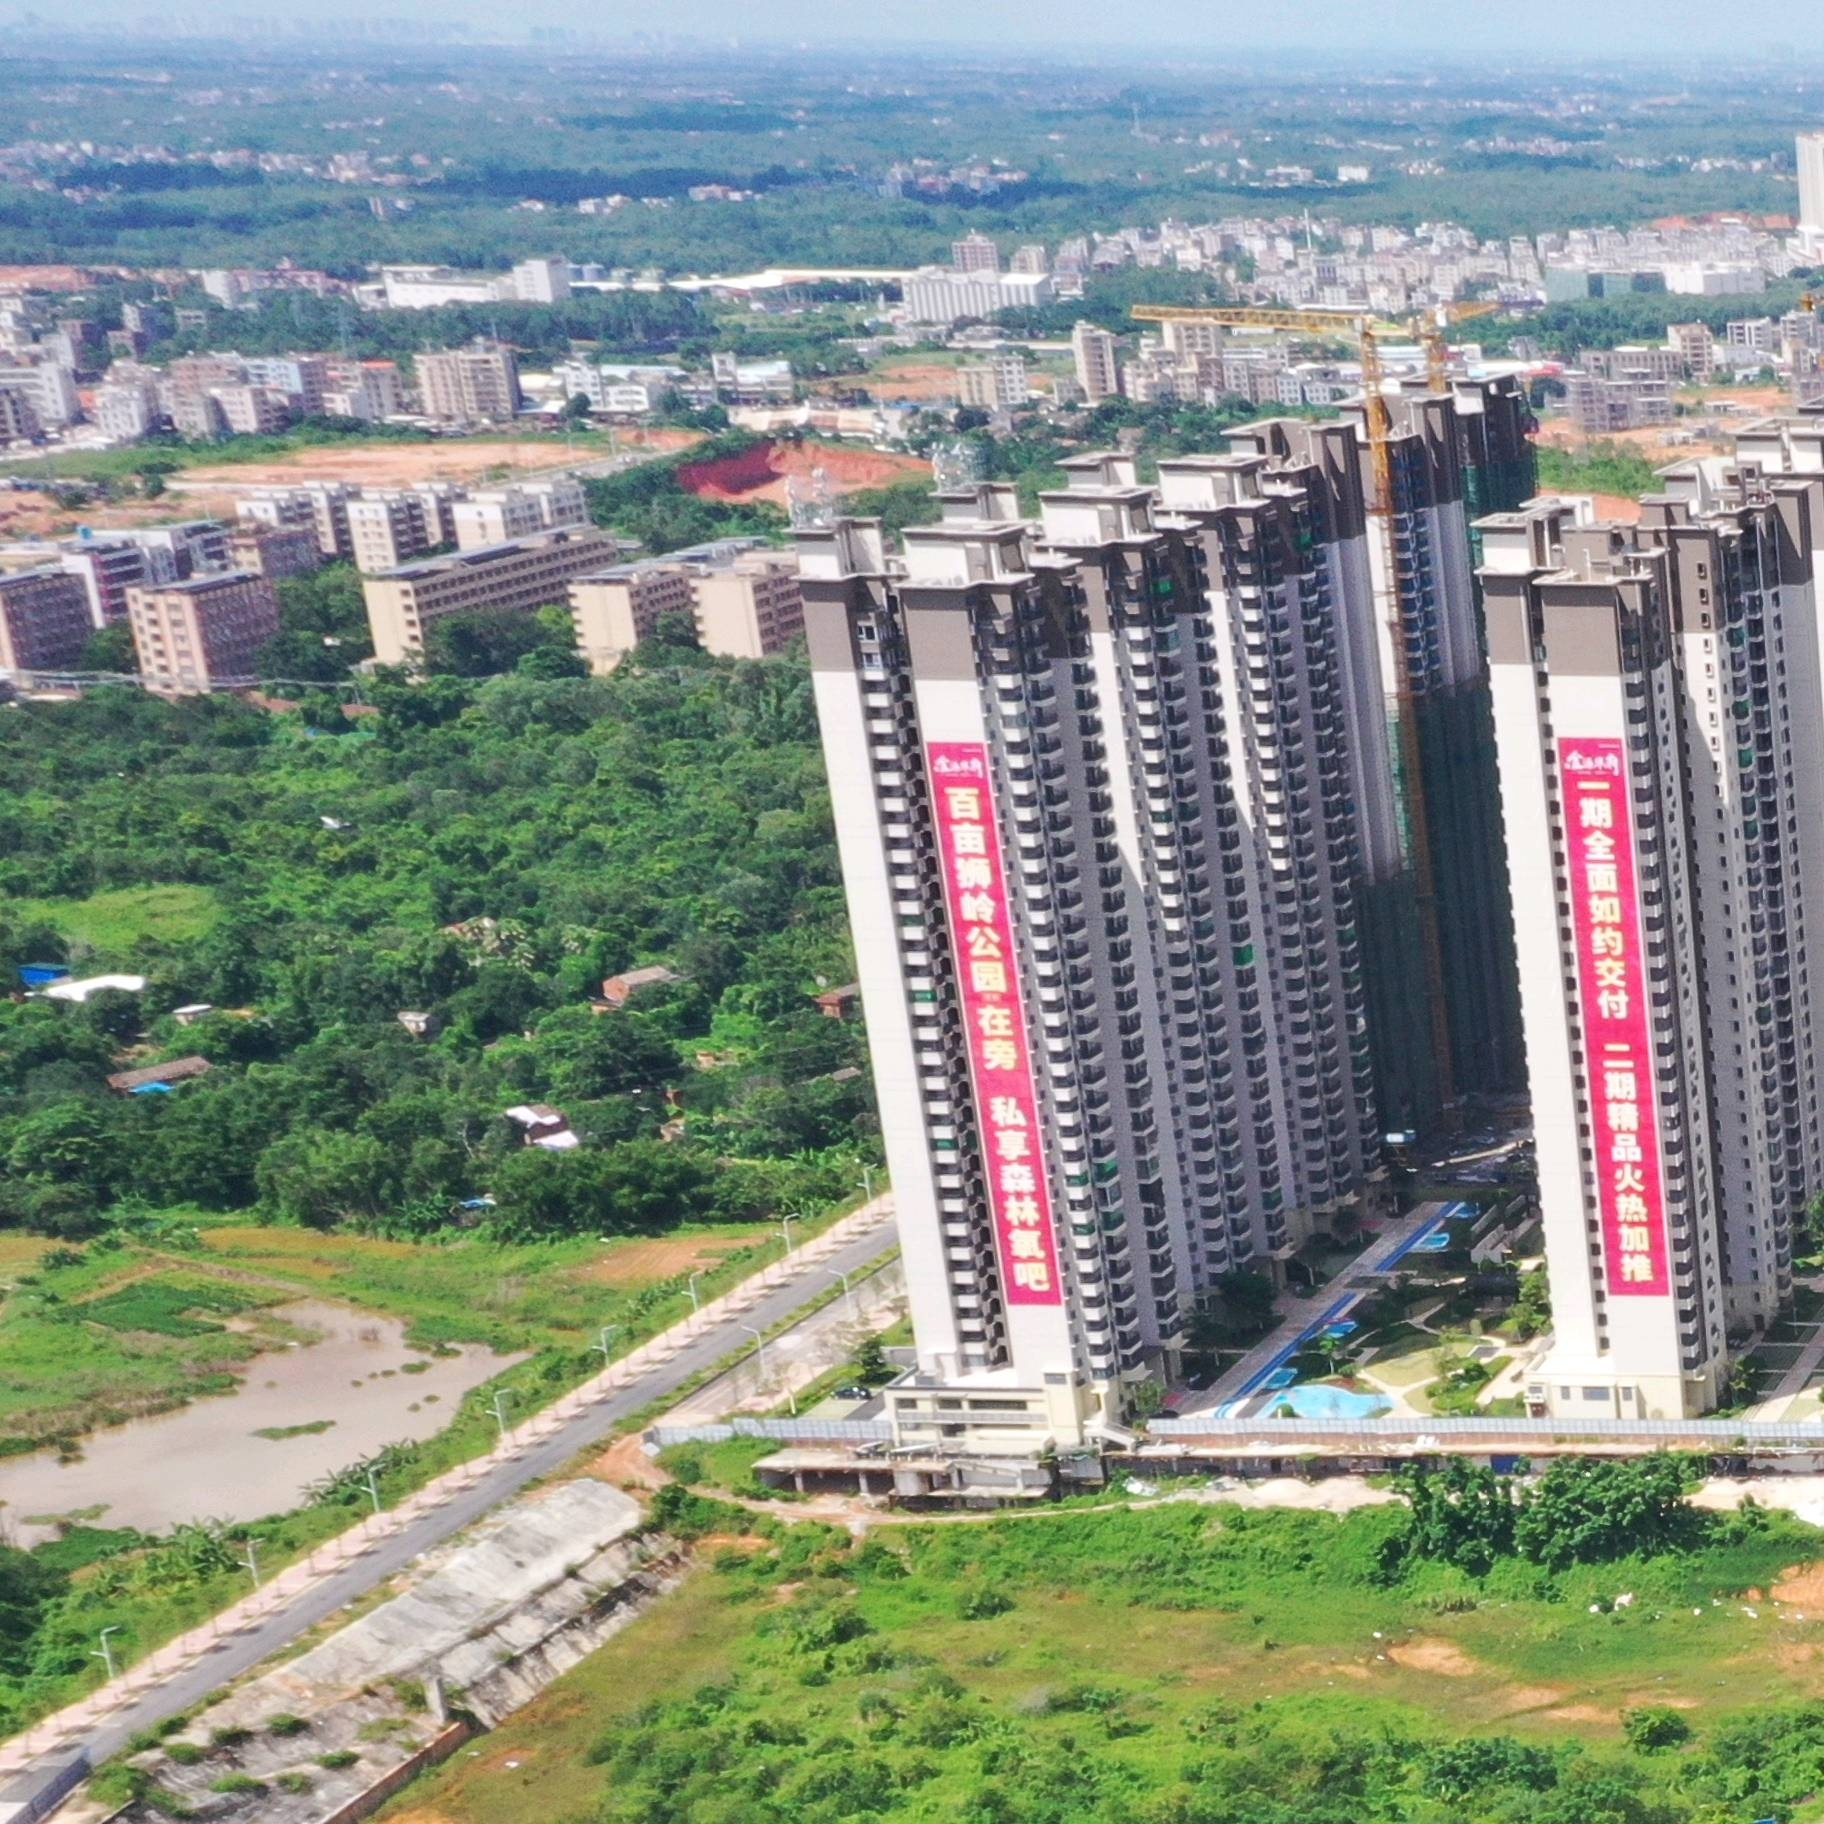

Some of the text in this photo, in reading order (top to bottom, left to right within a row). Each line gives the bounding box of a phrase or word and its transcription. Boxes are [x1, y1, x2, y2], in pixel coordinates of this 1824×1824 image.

[945, 787, 1050, 1293] 百亩狮岭公园在旁 私享森林氧吧
[1577, 780, 1629, 1021] 一期全面如约交付
[1603, 1042, 1654, 1284] 二期精品火热加推
